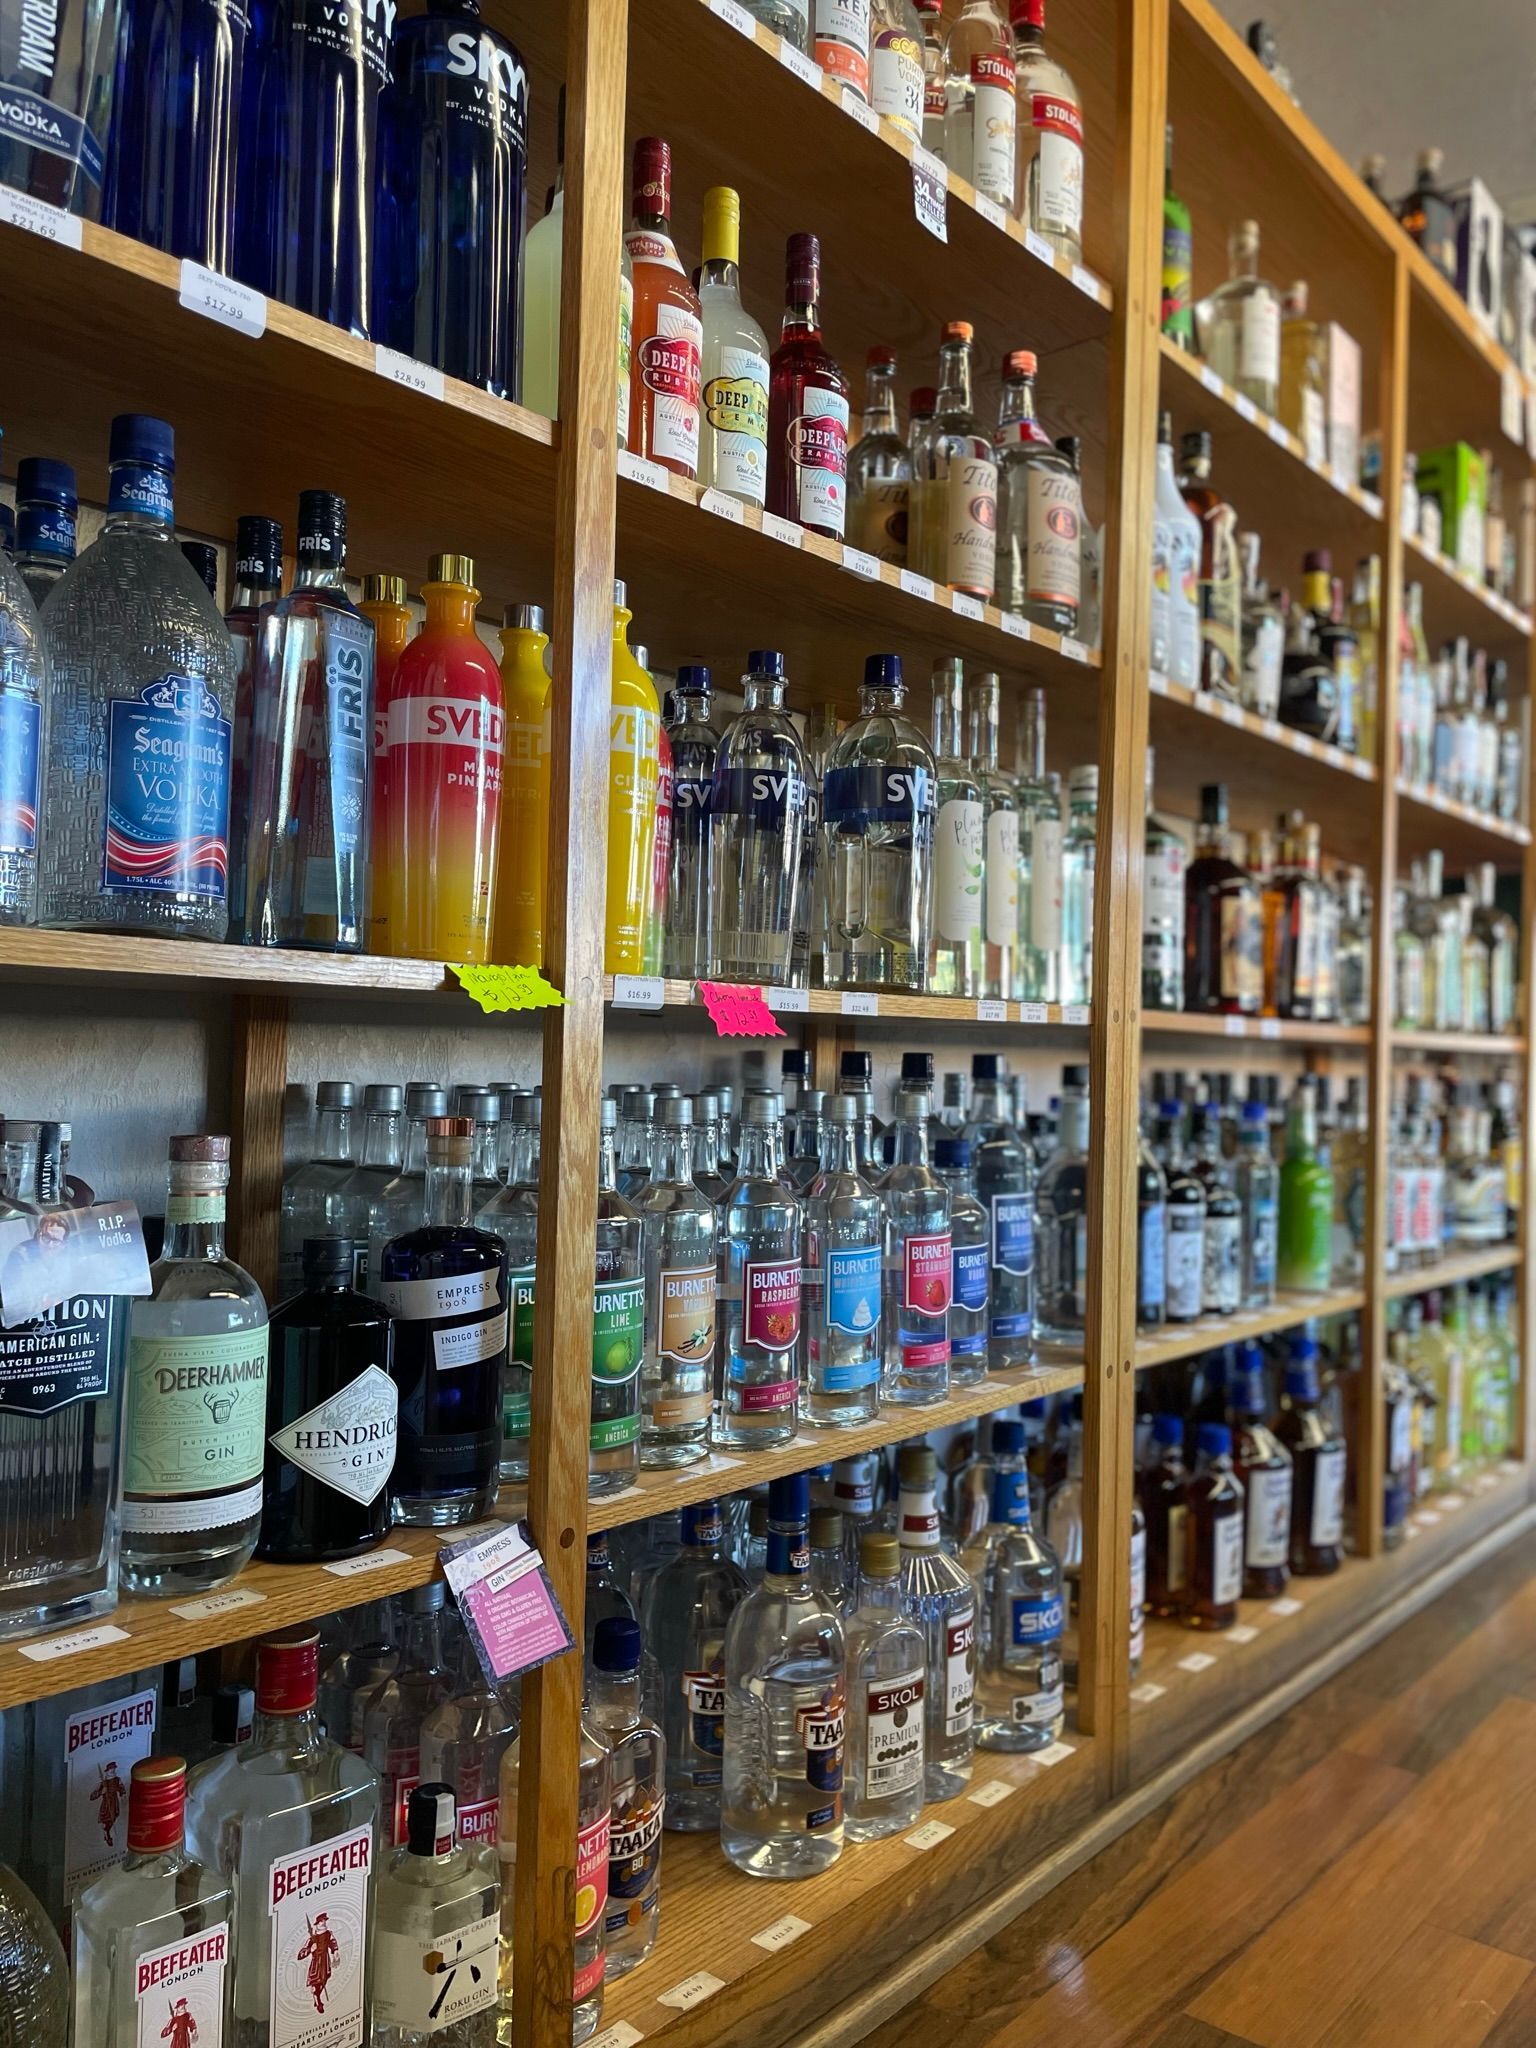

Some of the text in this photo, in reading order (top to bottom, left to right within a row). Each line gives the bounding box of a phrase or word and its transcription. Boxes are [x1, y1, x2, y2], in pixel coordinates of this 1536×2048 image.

[316, 26, 337, 39] 1992
[474, 85, 524, 129] VODKA
[10, 213, 57, 240] $21.69
[204, 294, 244, 321] $17.99
[651, 349, 687, 376] DEEP
[393, 369, 427, 390] $28.99
[715, 390, 749, 410] DEEP
[799, 425, 829, 445] DEEP
[299, 532, 332, 552] FRÏS
[133, 726, 224, 768] Seagram's
[132, 757, 177, 776] EXTRA
[136, 773, 222, 811] VODKA
[126, 876, 145, 884] 1.75L
[627, 989, 652, 1000] $16.99
[41, 1153, 53, 1200] AVIATION
[98, 1214, 126, 1232] R.I.P.
[98, 1231, 132, 1249] Vodka
[437, 1281, 491, 1300] EMPRESS
[439, 1297, 468, 1310] 1908
[610, 1312, 630, 1329] LIME
[0, 1335, 66, 1355] AMERICAN
[441, 1327, 488, 1345] INDIGO GIN
[35, 1349, 96, 1365] DISTILLED
[35, 1370, 60, 1378] AROUND
[84, 1380, 103, 1388] PROOF
[154, 1355, 265, 1394] DEERHAMMER
[32, 1383, 56, 1395] 0963
[183, 1437, 218, 1446] DUTCH
[605, 1431, 629, 1444] AMERICA
[204, 1446, 235, 1461] GIN
[352, 1447, 385, 1467] GIN
[477, 1537, 512, 1561] EMPRESS
[350, 1557, 385, 1570] $42.99
[491, 1575, 505, 1588] GIN
[205, 1597, 244, 1610] $32.99
[55, 1636, 99, 1651] $31.99
[877, 1688, 920, 1711] SKOL
[68, 1699, 154, 1754] BEEFEATER
[873, 1723, 921, 1748] PREMIUM
[91, 1730, 133, 1750] LONDON
[608, 1816, 661, 1858] TAAKA
[272, 1836, 369, 1906] BEEFEATER
[631, 1856, 644, 1872] 80
[298, 1873, 347, 1900] LONDON
[419, 1921, 492, 1951] THE JAPANESE CRAFT
[138, 1933, 226, 1995] BEEFEATER
[161, 1965, 205, 1989] LONDON
[444, 1987, 489, 2014] ROKU GIN
[682, 1984, 703, 1999] $6.99
[297, 2021, 330, 2040] DISTILLED
[318, 2030, 328, 2039] OF
[330, 2013, 361, 2032] LONDON
